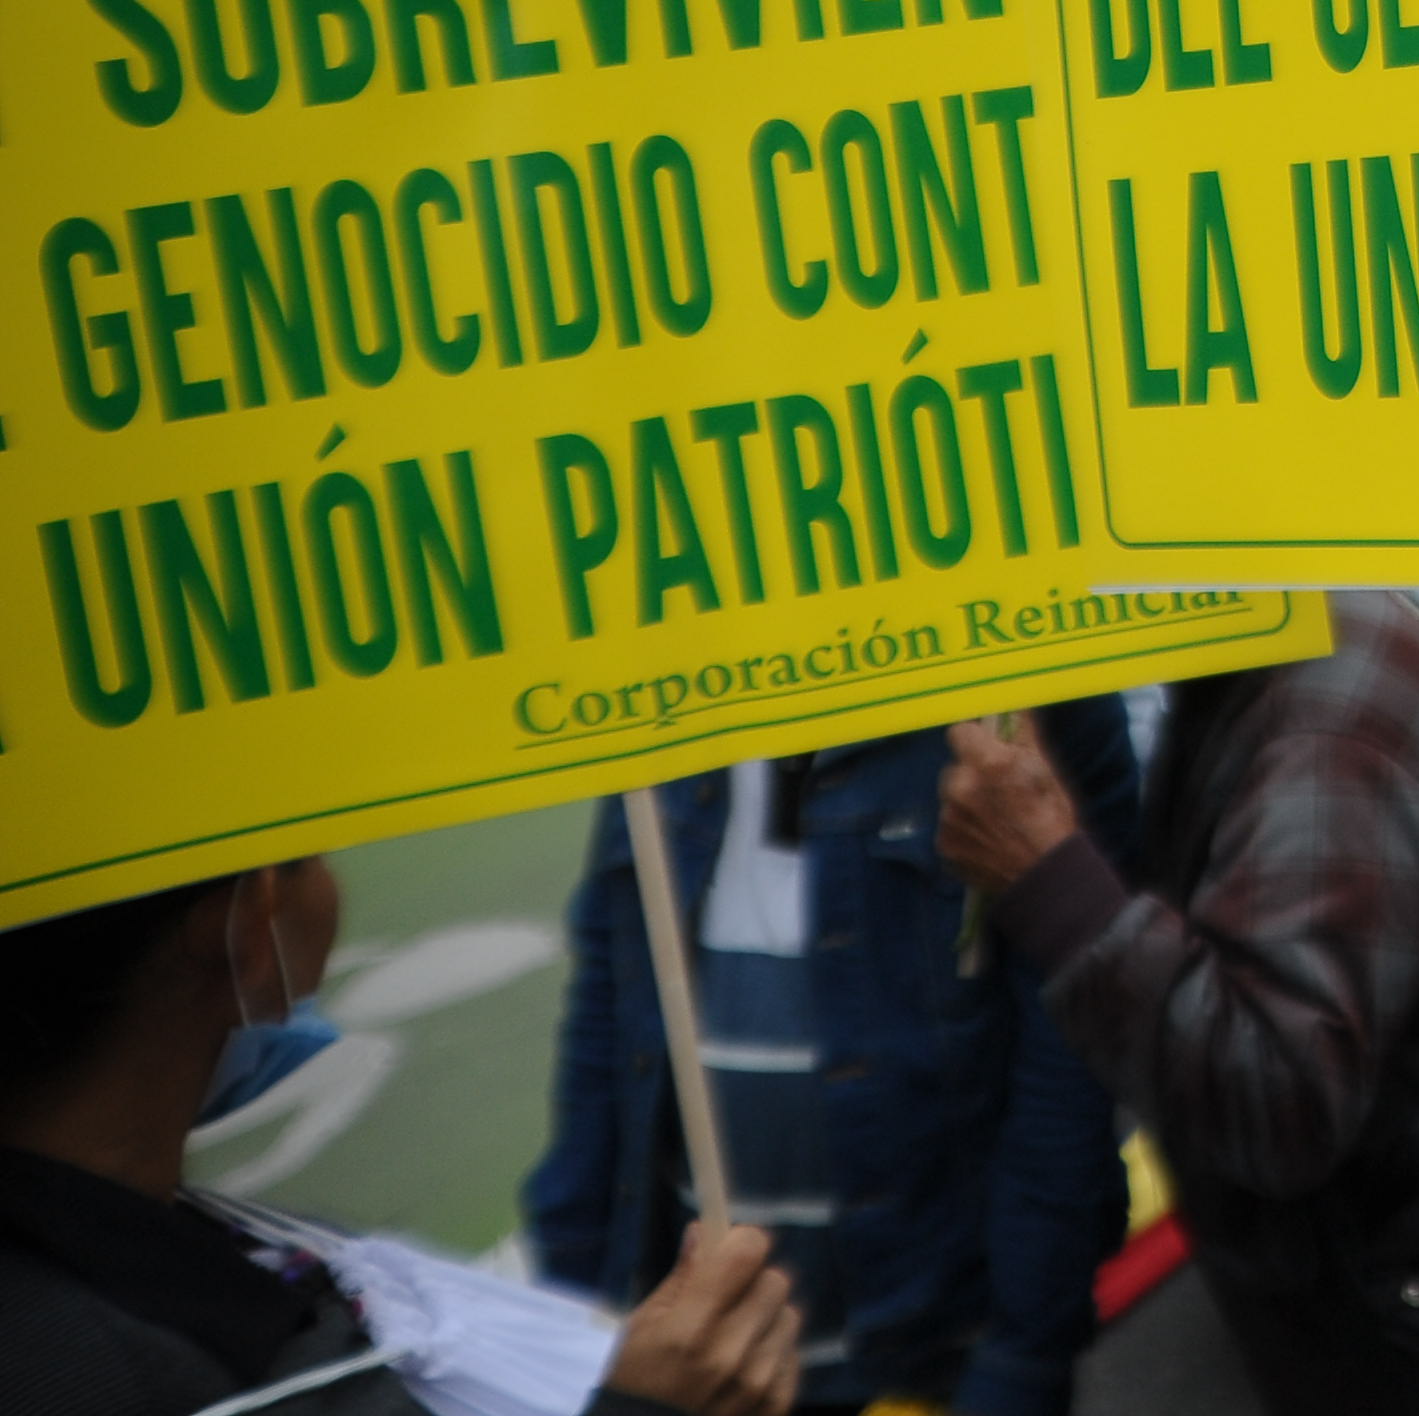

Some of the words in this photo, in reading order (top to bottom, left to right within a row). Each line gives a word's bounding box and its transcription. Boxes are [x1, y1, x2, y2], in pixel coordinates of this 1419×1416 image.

[39, 132, 715, 434] GENOCIDIO
[749, 84, 1042, 322] CONT
[1108, 169, 1260, 407] LA
[37, 422, 507, 729] UNIÓN
[535, 327, 1083, 641] PATRIÓTI
[513, 618, 944, 737] Corporación
